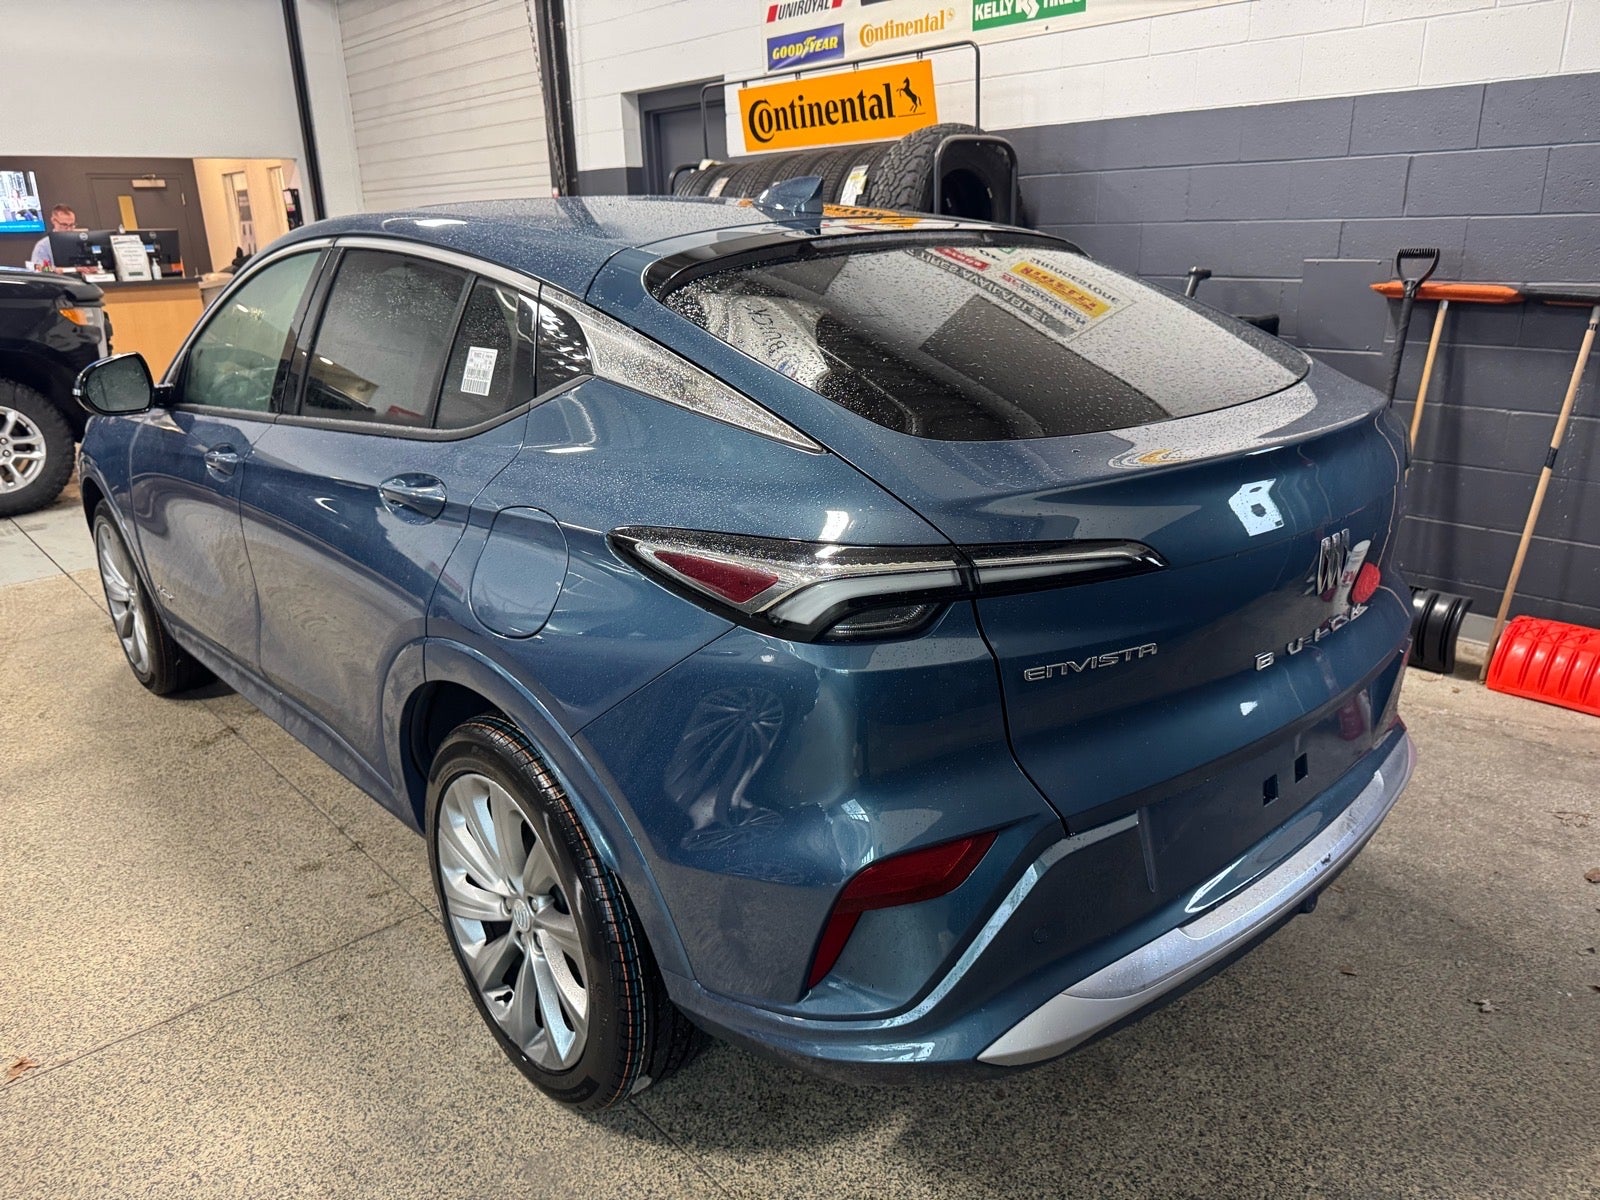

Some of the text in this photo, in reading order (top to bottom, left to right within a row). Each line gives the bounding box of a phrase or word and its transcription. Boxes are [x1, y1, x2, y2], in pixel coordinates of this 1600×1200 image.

[778, 0, 830, 20] UNIROYAL
[859, 9, 945, 48] Continental
[974, 0, 1013, 21] KELLY
[772, 36, 838, 60] GOODYEAR
[748, 82, 896, 143] Continental
[1255, 602, 1369, 671] BUICK
[1024, 642, 1158, 681] ENVISTA
